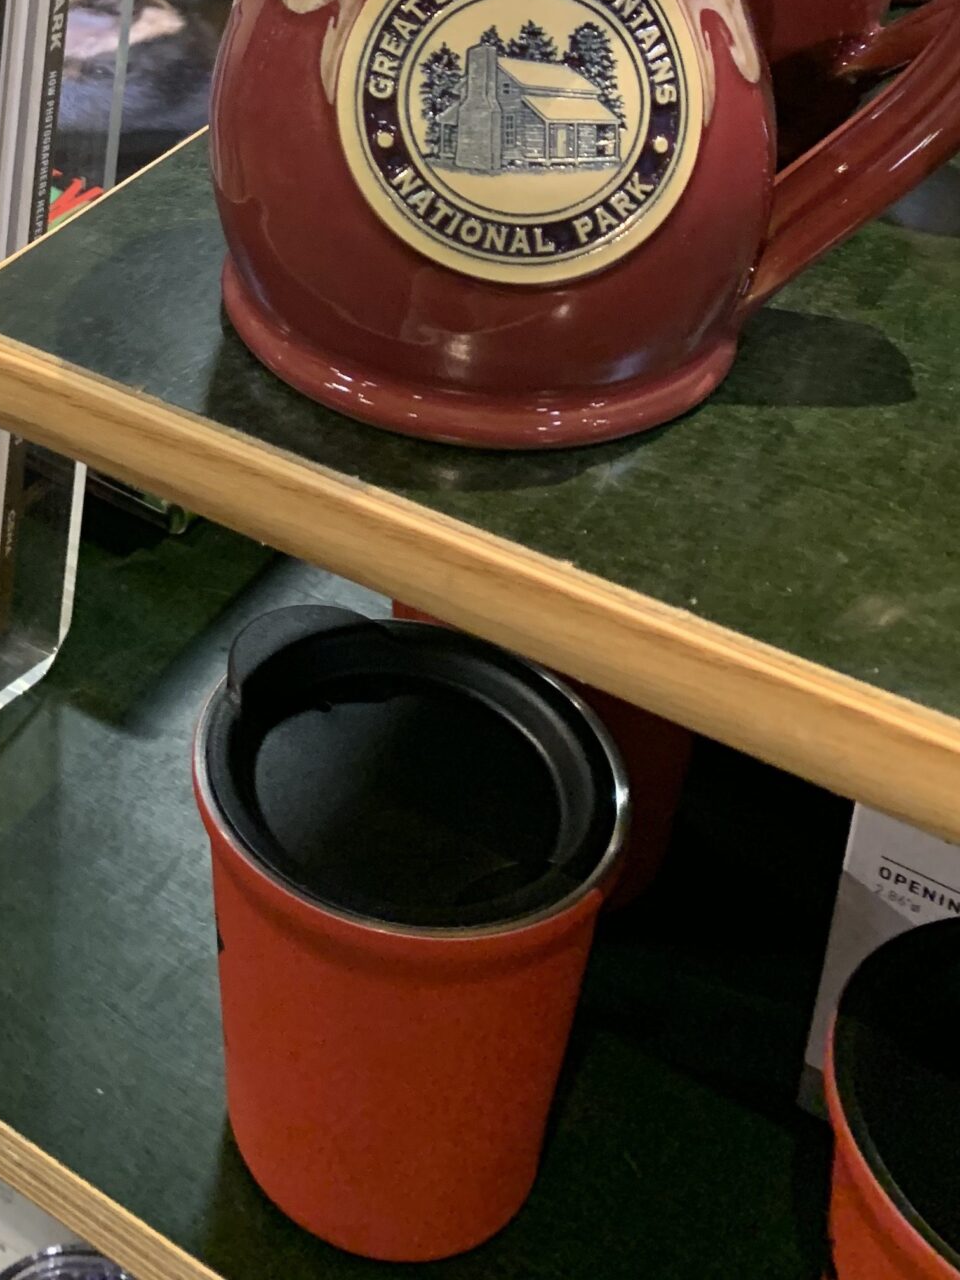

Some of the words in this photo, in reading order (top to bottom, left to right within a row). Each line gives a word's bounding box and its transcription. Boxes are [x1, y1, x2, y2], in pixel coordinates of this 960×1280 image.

[47, 70, 58, 97] HOW
[37, 99, 56, 198] PHOTOGRAPHERS
[390, 166, 557, 256] NATIONAL
[573, 170, 657, 245] PARK
